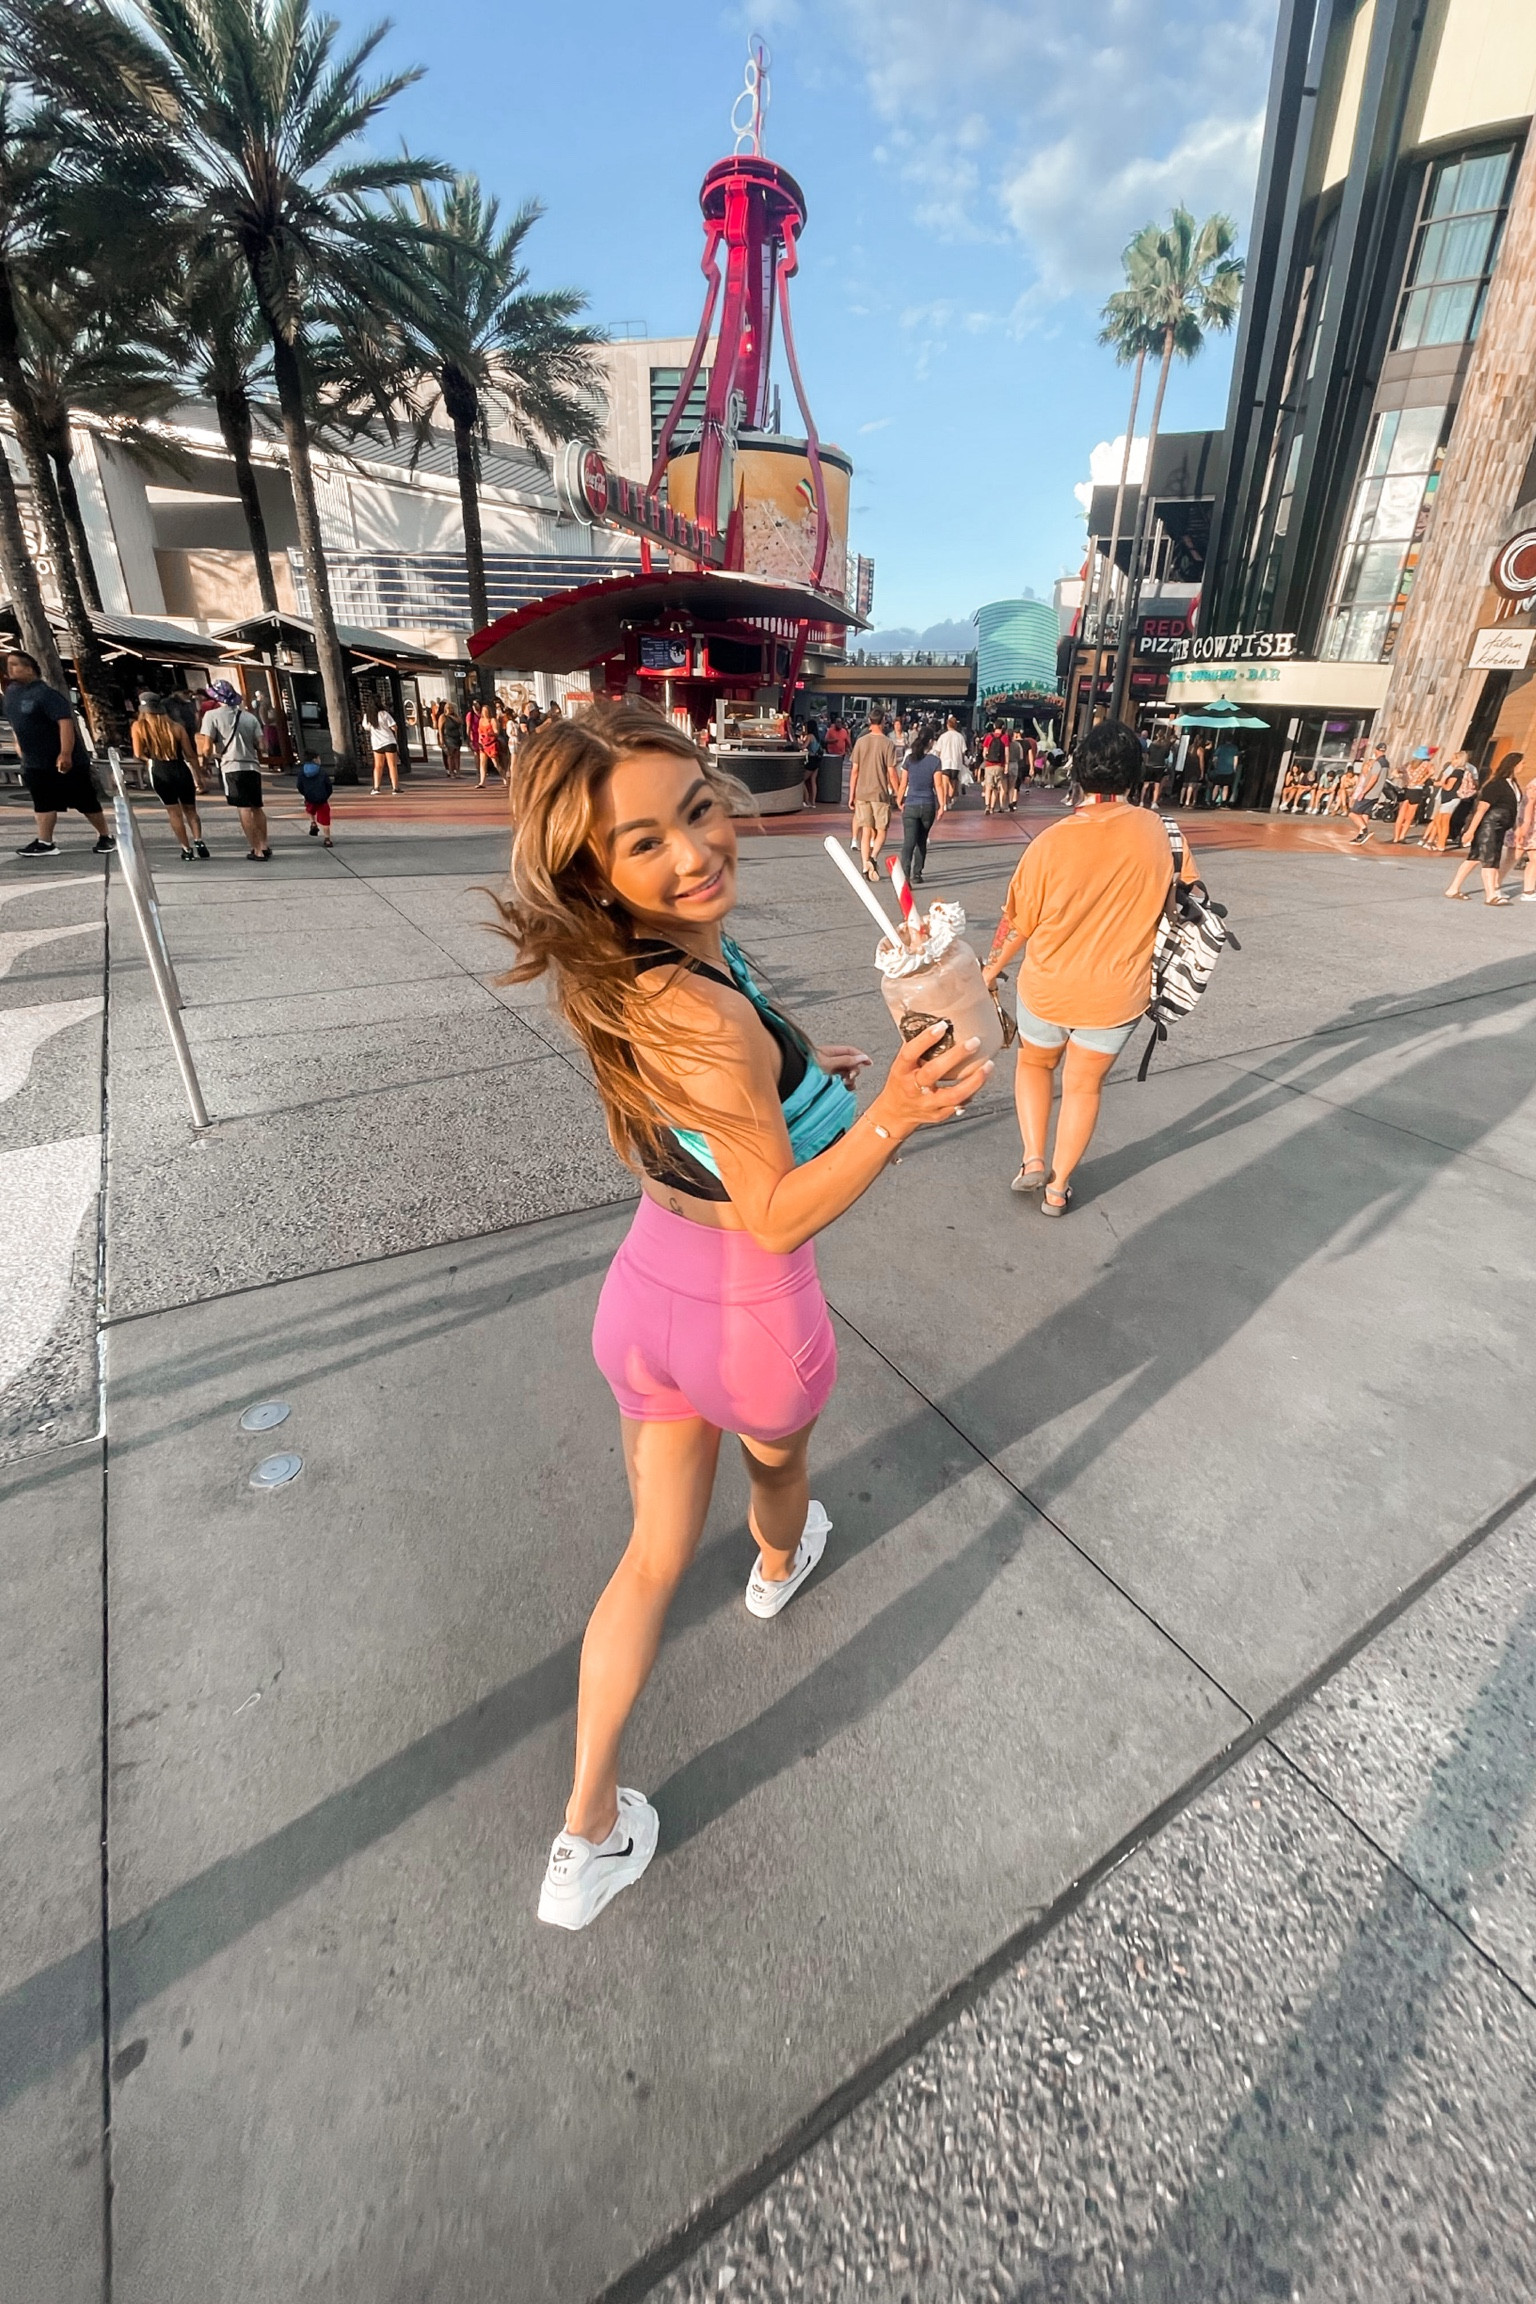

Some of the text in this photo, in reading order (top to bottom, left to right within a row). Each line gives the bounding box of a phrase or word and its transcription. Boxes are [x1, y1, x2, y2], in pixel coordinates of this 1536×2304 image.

[1143, 619, 1185, 636] RED
[1140, 637, 1182, 653] PIZZ
[1193, 632, 1296, 659] COWFISH
[1246, 668, 1280, 682] BAR
